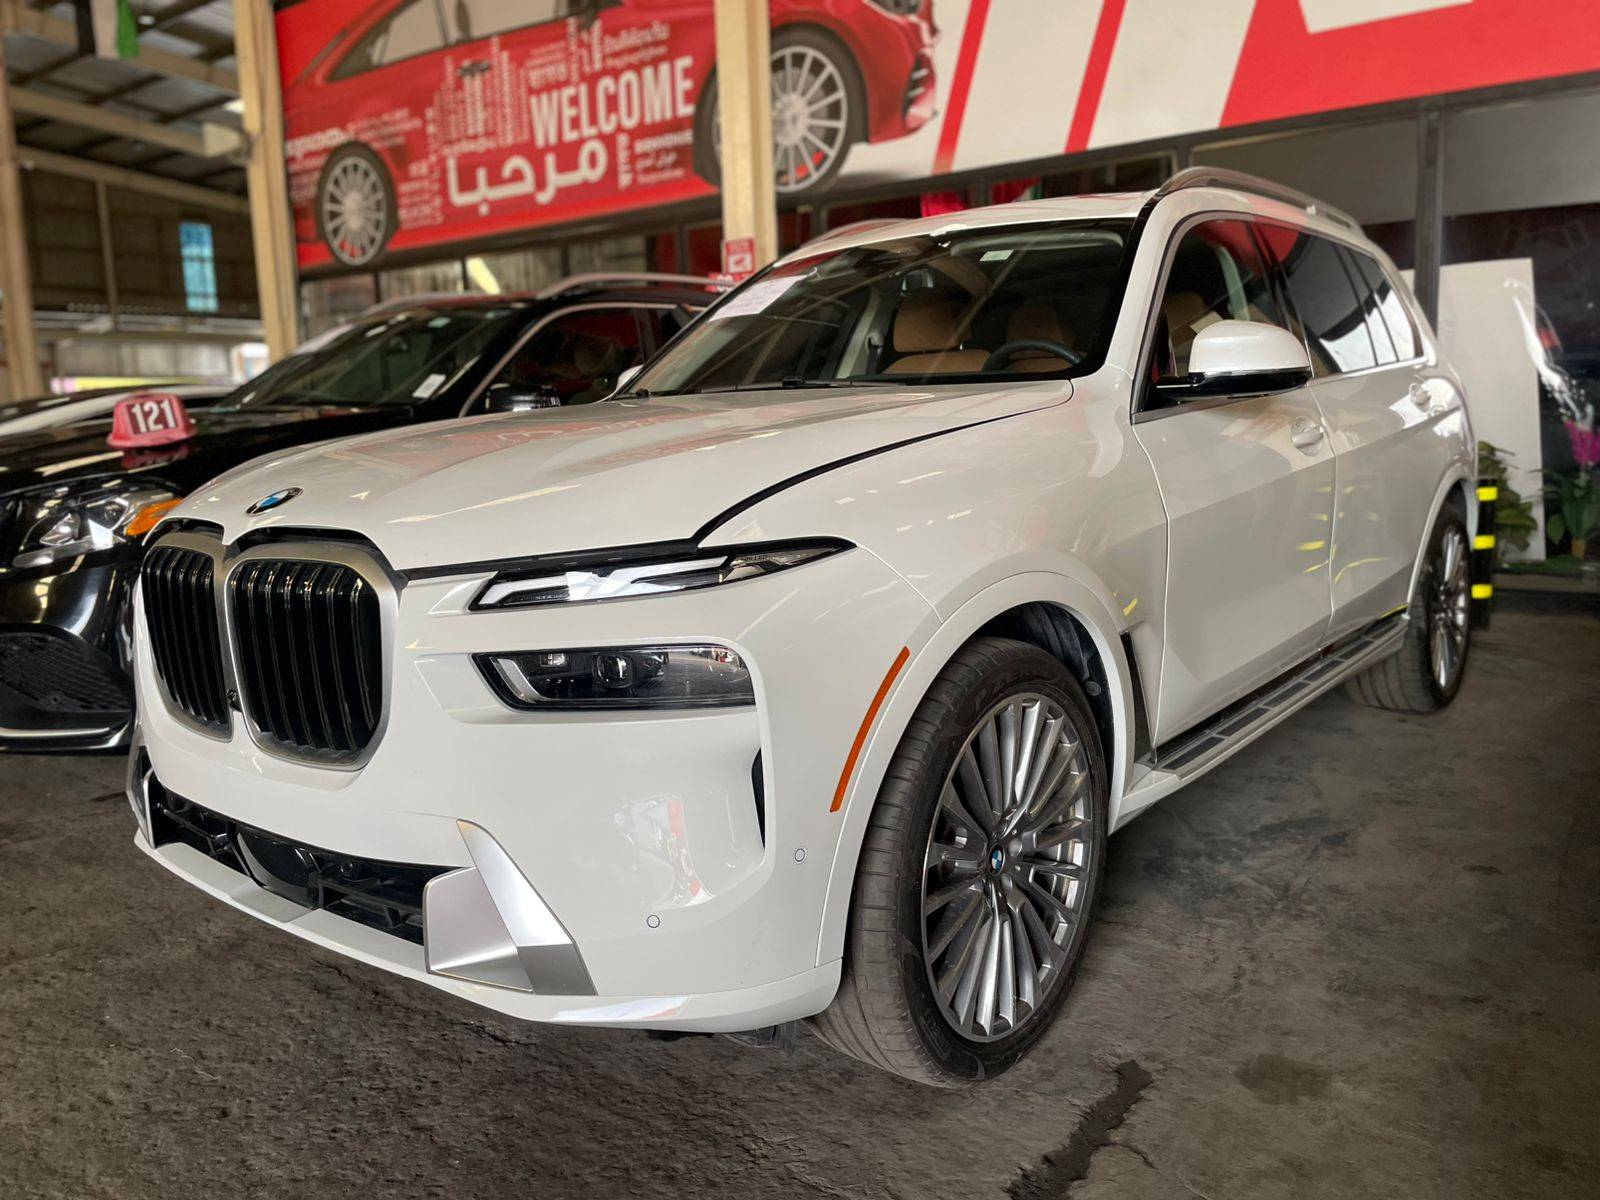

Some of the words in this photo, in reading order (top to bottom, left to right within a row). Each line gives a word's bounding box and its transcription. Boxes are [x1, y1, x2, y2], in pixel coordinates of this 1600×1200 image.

[529, 55, 695, 149] WELCOME
[446, 137, 608, 217] مرحبا
[131, 398, 177, 435] 121
